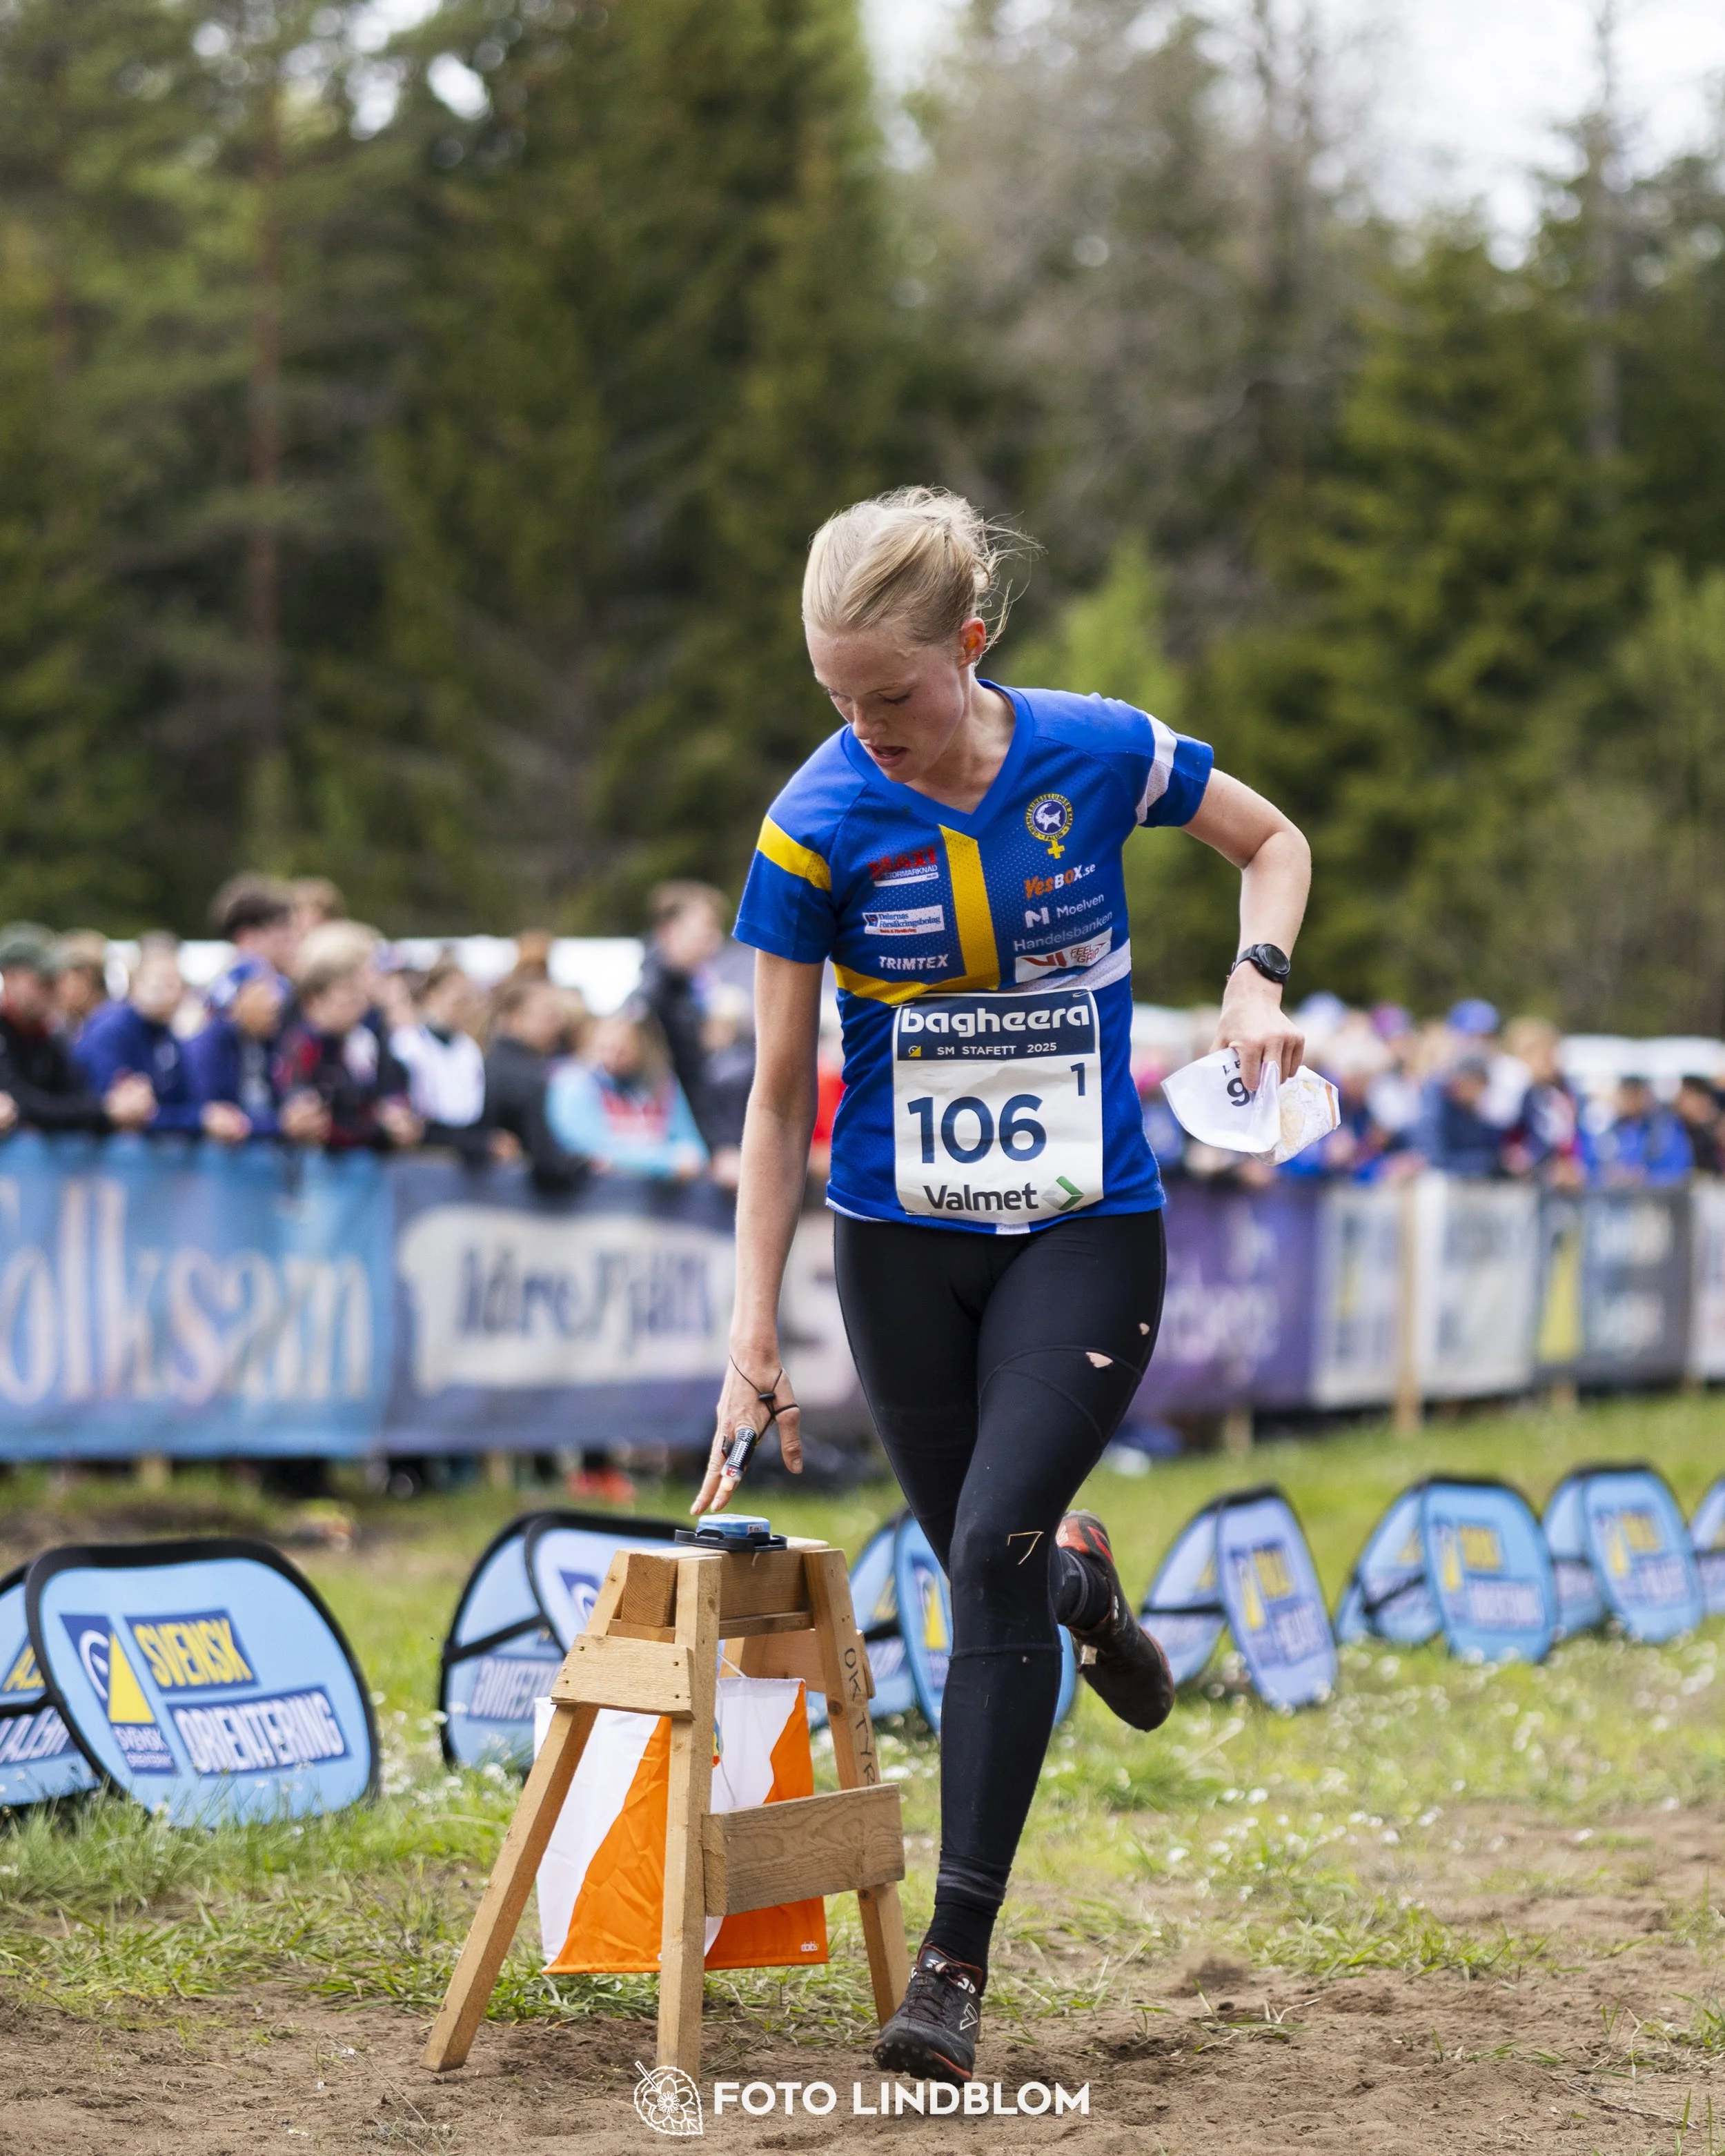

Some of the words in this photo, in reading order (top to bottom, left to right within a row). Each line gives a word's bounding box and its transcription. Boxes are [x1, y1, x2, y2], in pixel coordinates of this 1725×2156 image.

[885, 864, 938, 879] STORMARKNAD
[1056, 893, 1104, 918] Moelven
[879, 916, 941, 928] Försäkringsbolag
[1014, 911, 1112, 951] Handelsbanken
[879, 953, 949, 971] TRIMTEX
[1070, 945, 1093, 957] FEEL
[1077, 947, 1100, 963] GRIP
[901, 1005, 1090, 1038] bagheera
[937, 1046, 955, 1056] SM
[962, 1045, 1017, 1056] STAFETT
[1027, 1042, 1057, 1054] 2025
[1070, 1062, 1086, 1096] 1
[907, 1094, 1047, 1164] 106
[923, 1182, 1040, 1211] Valmet
[0, 1176, 373, 1406] olksam
[133, 1617, 253, 1688] SVENSK
[174, 1690, 344, 1774] ORIENTERING
